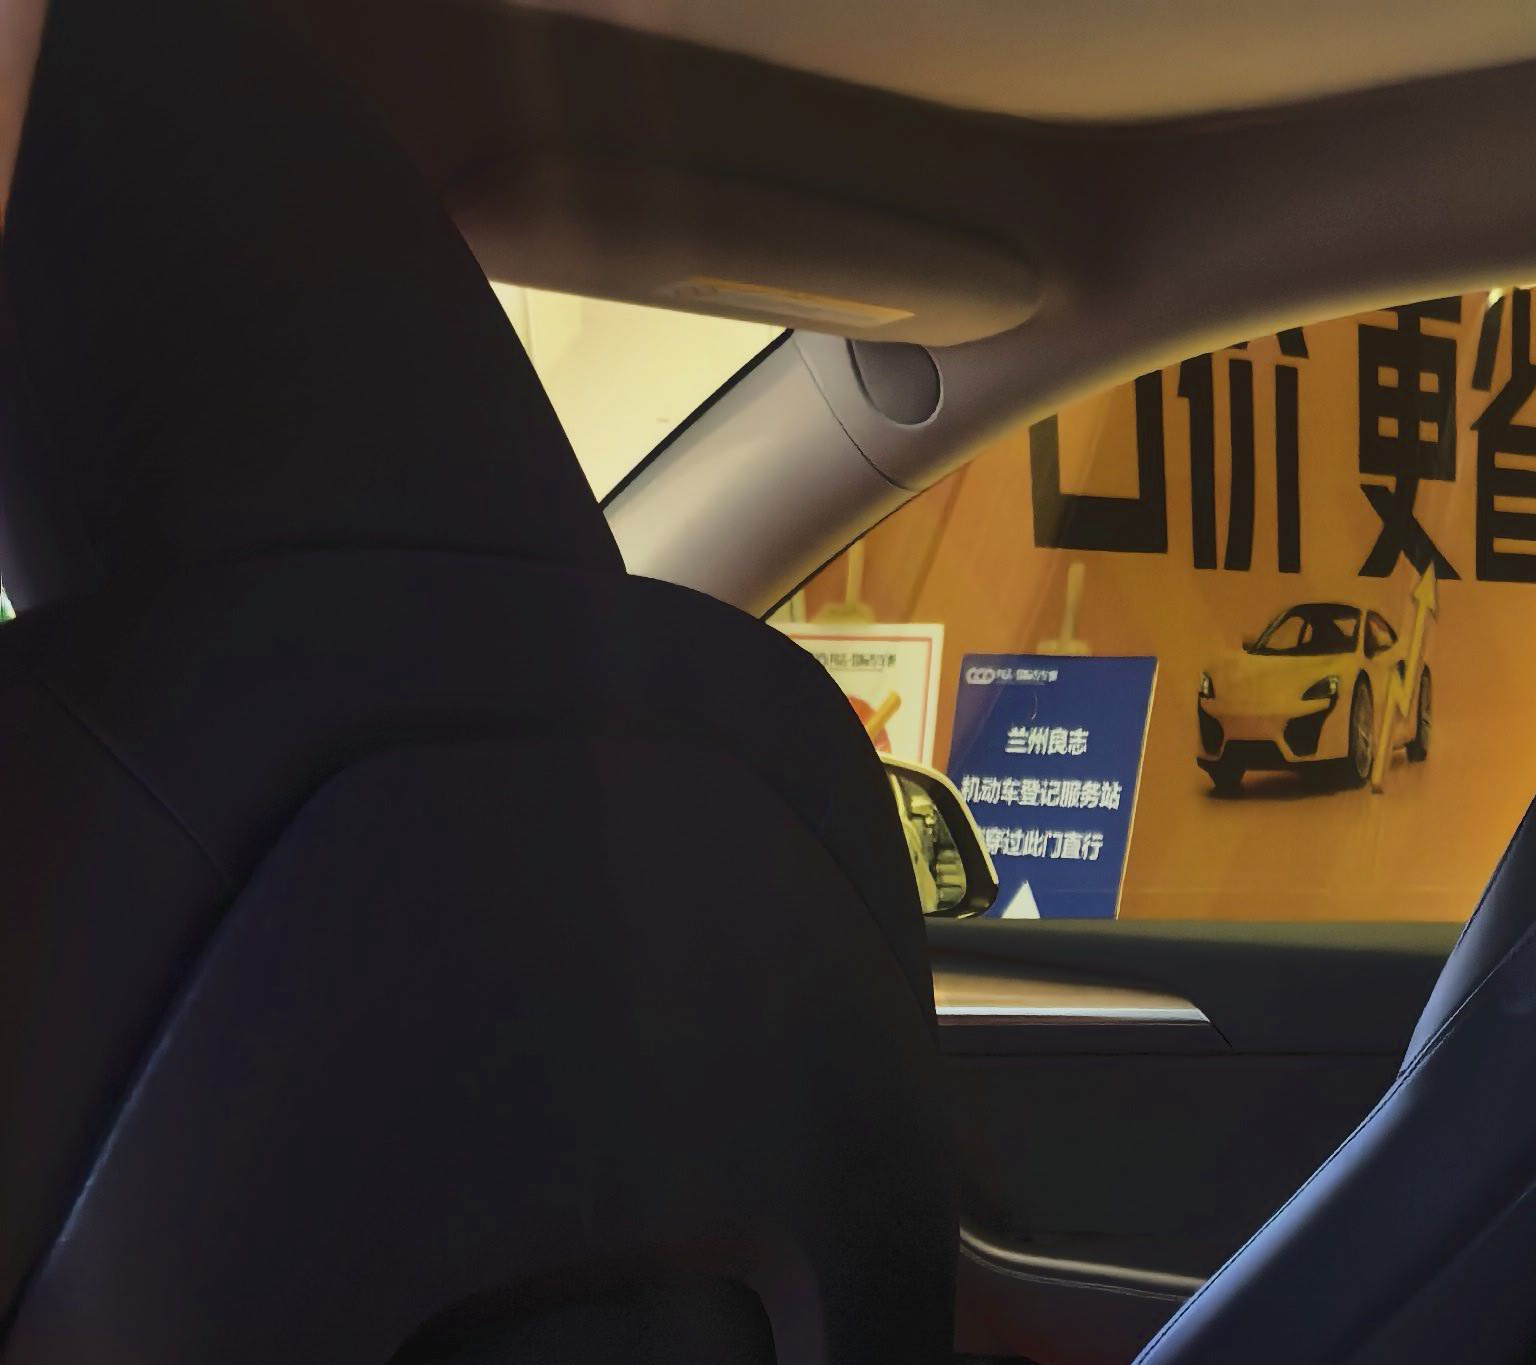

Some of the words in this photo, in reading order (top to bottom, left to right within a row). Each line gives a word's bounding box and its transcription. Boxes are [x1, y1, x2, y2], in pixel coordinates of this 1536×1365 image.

[1005, 727, 1089, 755] 兰州良志
[961, 775, 1122, 810] 机动车登记服务站
[979, 828, 1104, 860] 穿过此门直行
